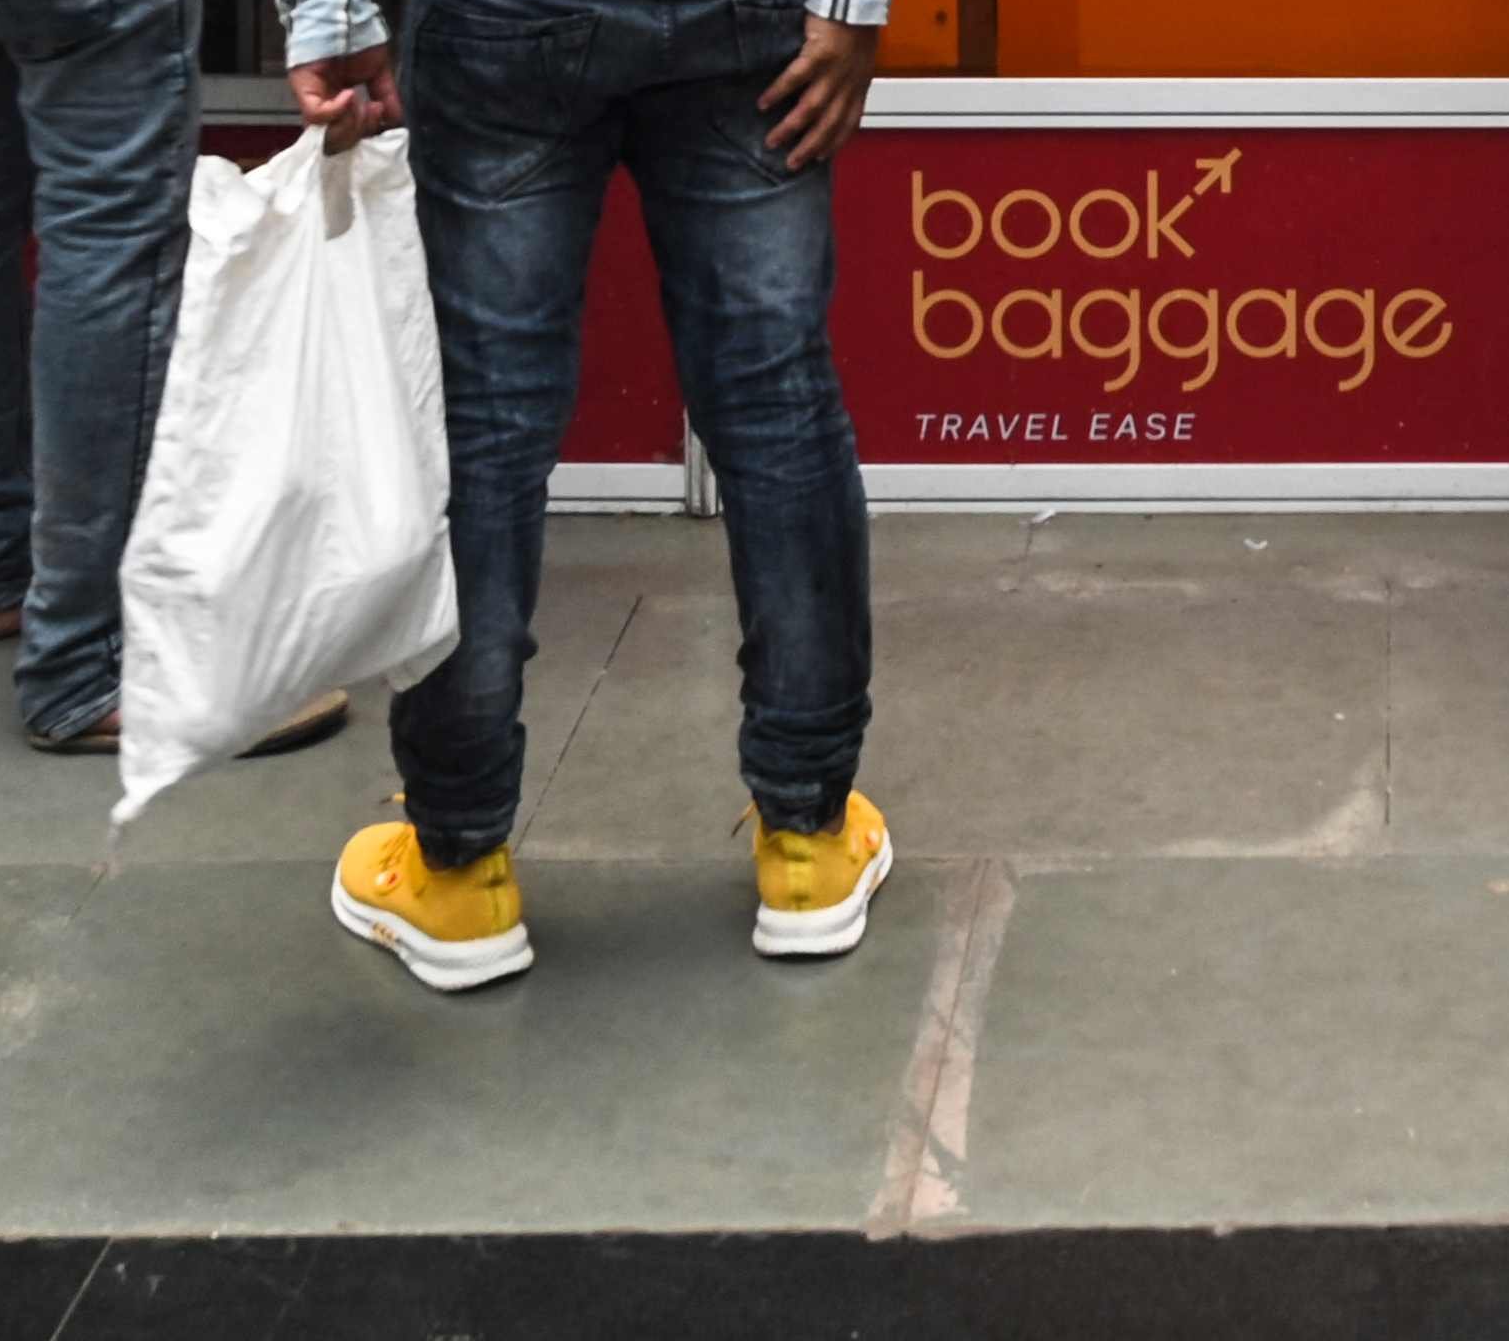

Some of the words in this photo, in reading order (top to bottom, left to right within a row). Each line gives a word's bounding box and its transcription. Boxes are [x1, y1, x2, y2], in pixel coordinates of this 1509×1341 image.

[912, 170, 1196, 259] book
[912, 270, 1453, 392] baggage
[916, 413, 1070, 442] TRAVEL
[1089, 412, 1198, 442] EASE
